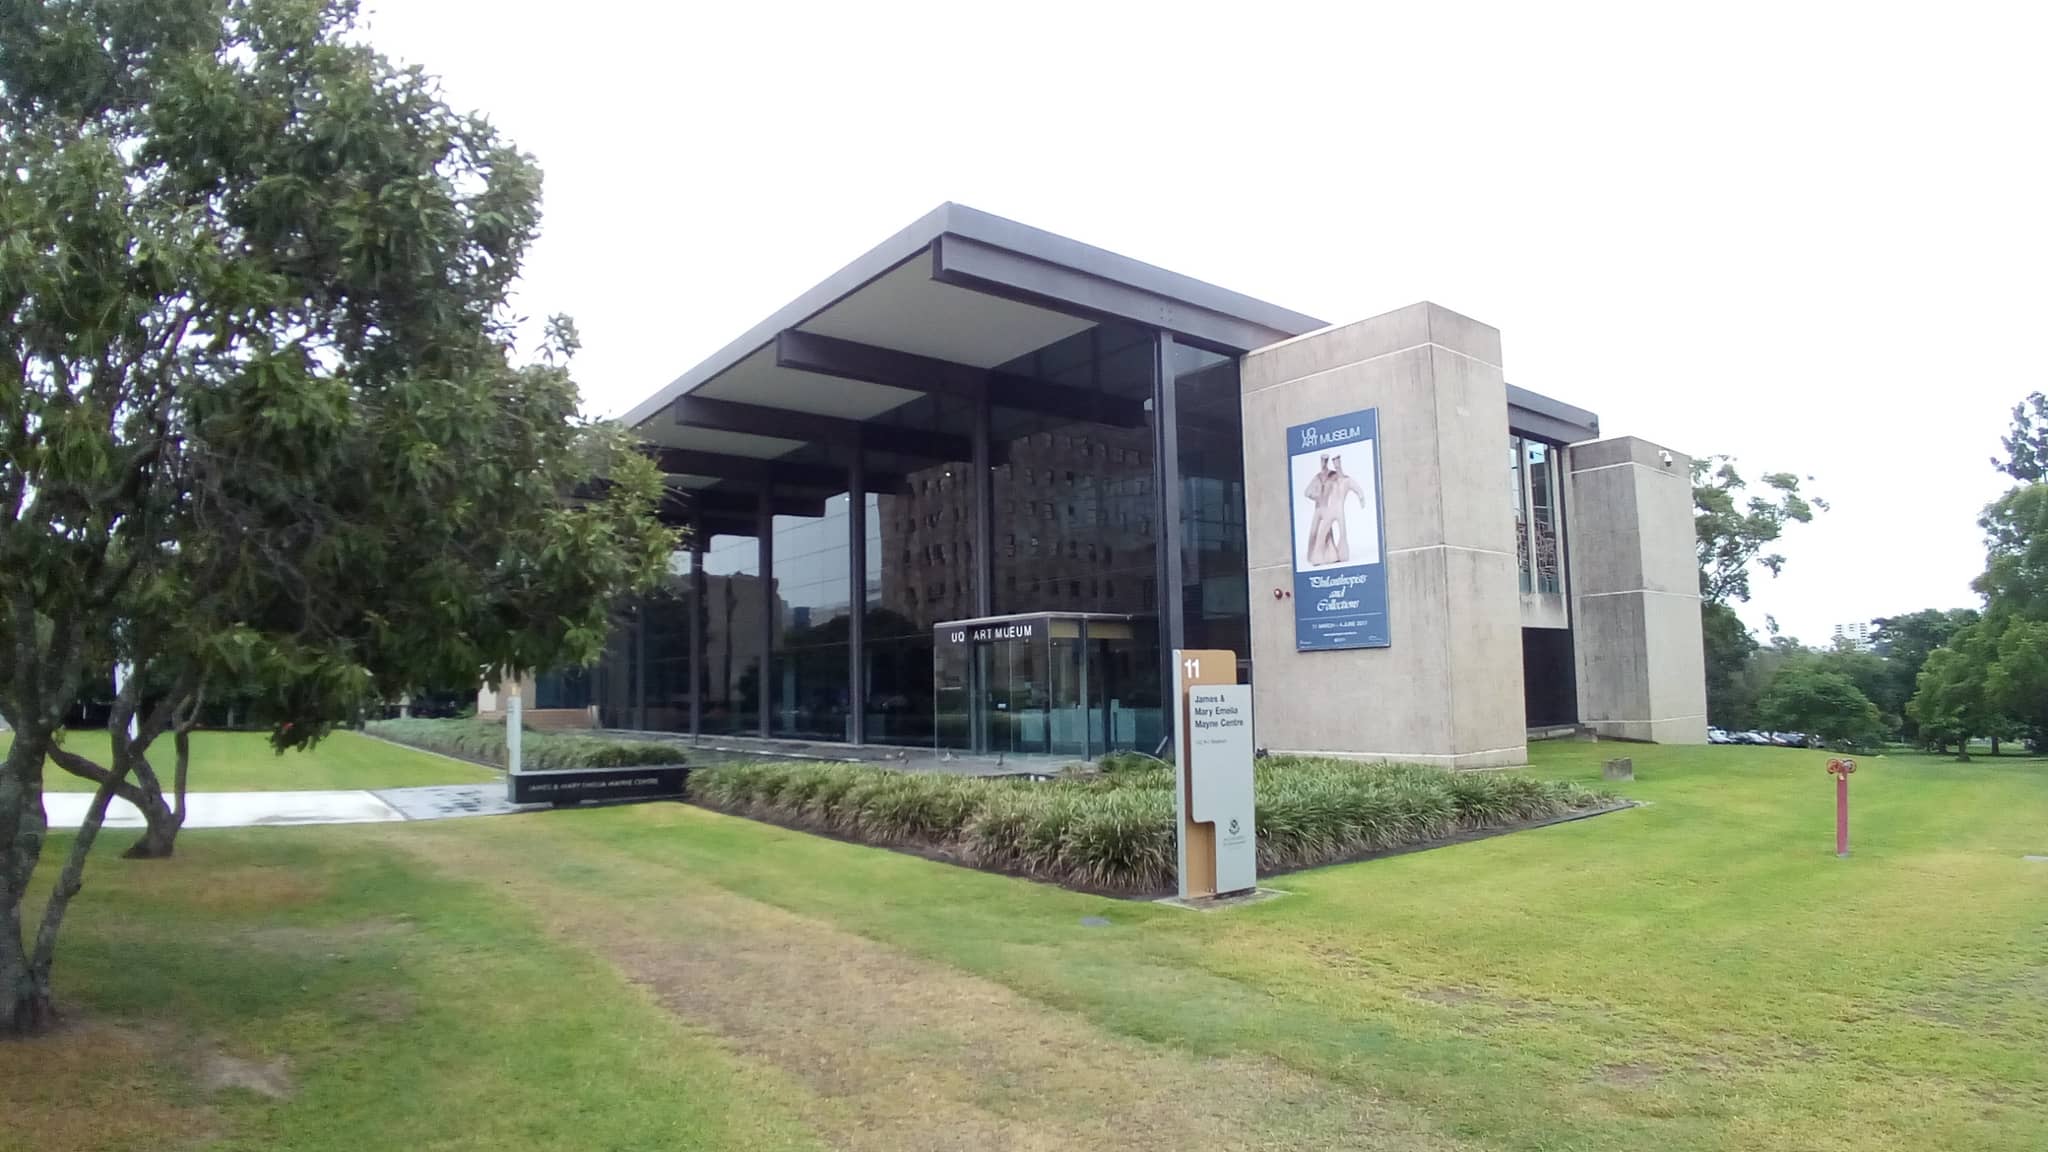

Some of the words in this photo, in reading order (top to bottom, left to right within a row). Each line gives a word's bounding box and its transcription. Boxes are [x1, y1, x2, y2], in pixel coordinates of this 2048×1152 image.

[1301, 427, 1316, 438] UQ
[1301, 435, 1318, 448] ART
[1320, 426, 1361, 445] MUSEUM
[973, 628, 993, 641] ART
[994, 625, 1033, 639] MUEUM
[1184, 658, 1200, 679] 11
[1195, 695, 1218, 703] James
[1195, 707, 1213, 717] Mary
[1215, 706, 1238, 715] Emelia
[1195, 720, 1218, 730] Mayne
[1220, 718, 1244, 727] Centre
